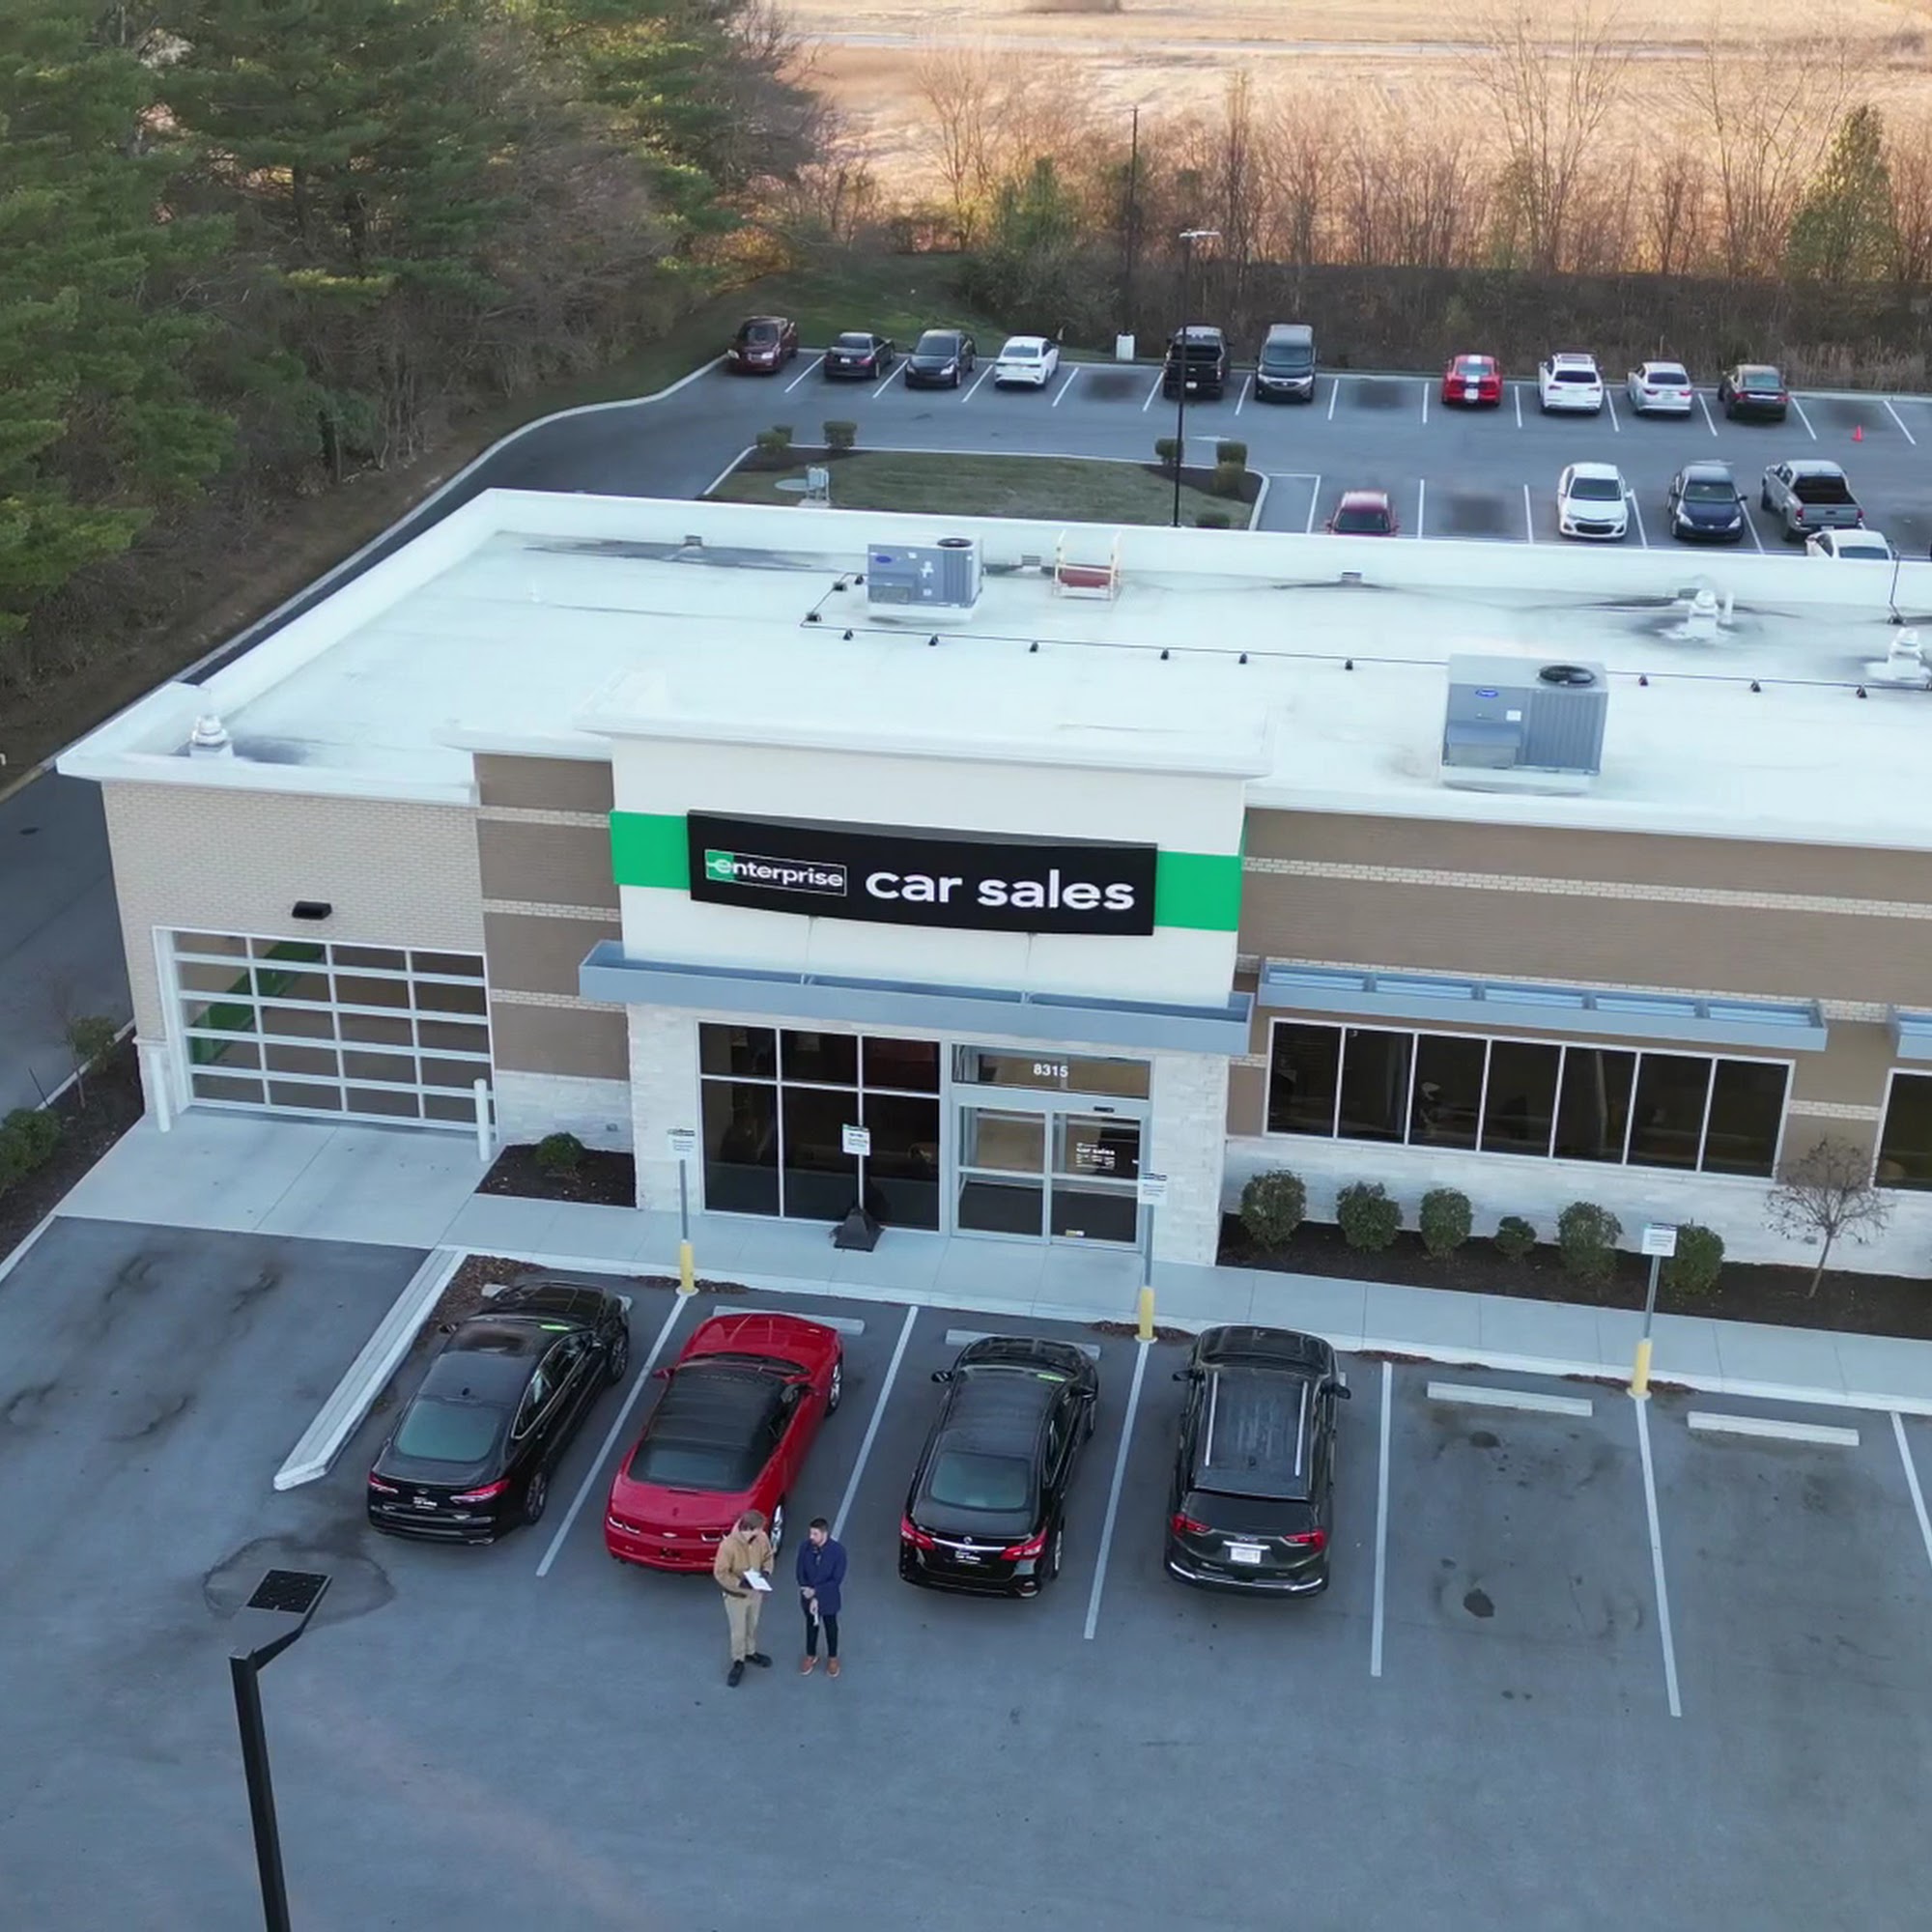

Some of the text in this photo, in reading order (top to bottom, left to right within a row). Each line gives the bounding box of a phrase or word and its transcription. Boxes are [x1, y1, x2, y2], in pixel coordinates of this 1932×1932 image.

[708, 859, 1135, 910] enterprise car sales
[1033, 1063, 1068, 1078] 8315
